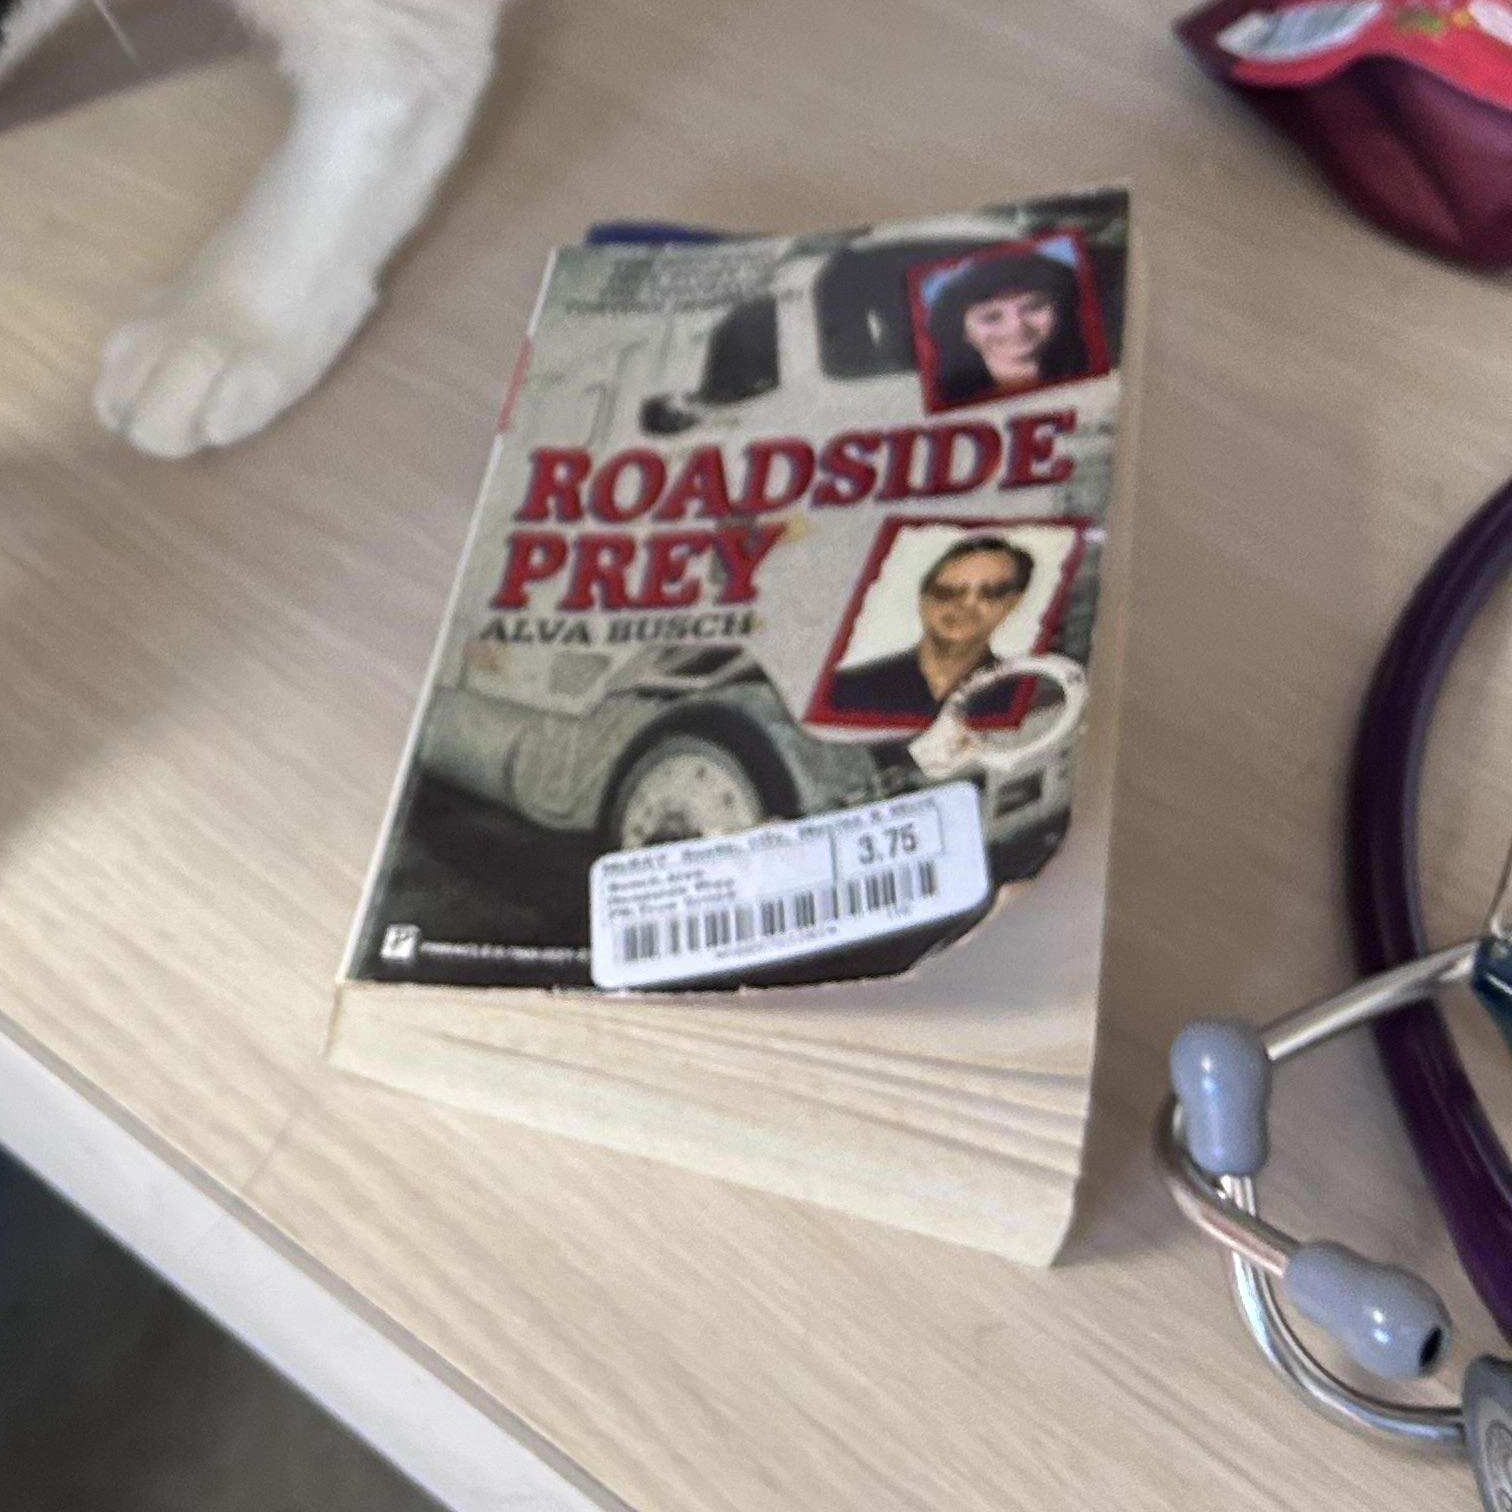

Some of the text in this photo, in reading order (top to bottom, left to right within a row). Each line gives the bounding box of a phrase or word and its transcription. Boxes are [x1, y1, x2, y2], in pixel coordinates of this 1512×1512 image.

[514, 409, 1077, 522] ROADSIDE
[490, 521, 786, 613] PREY
[479, 611, 756, 646] ALVA BUSCH
[857, 824, 919, 866] 3.75
